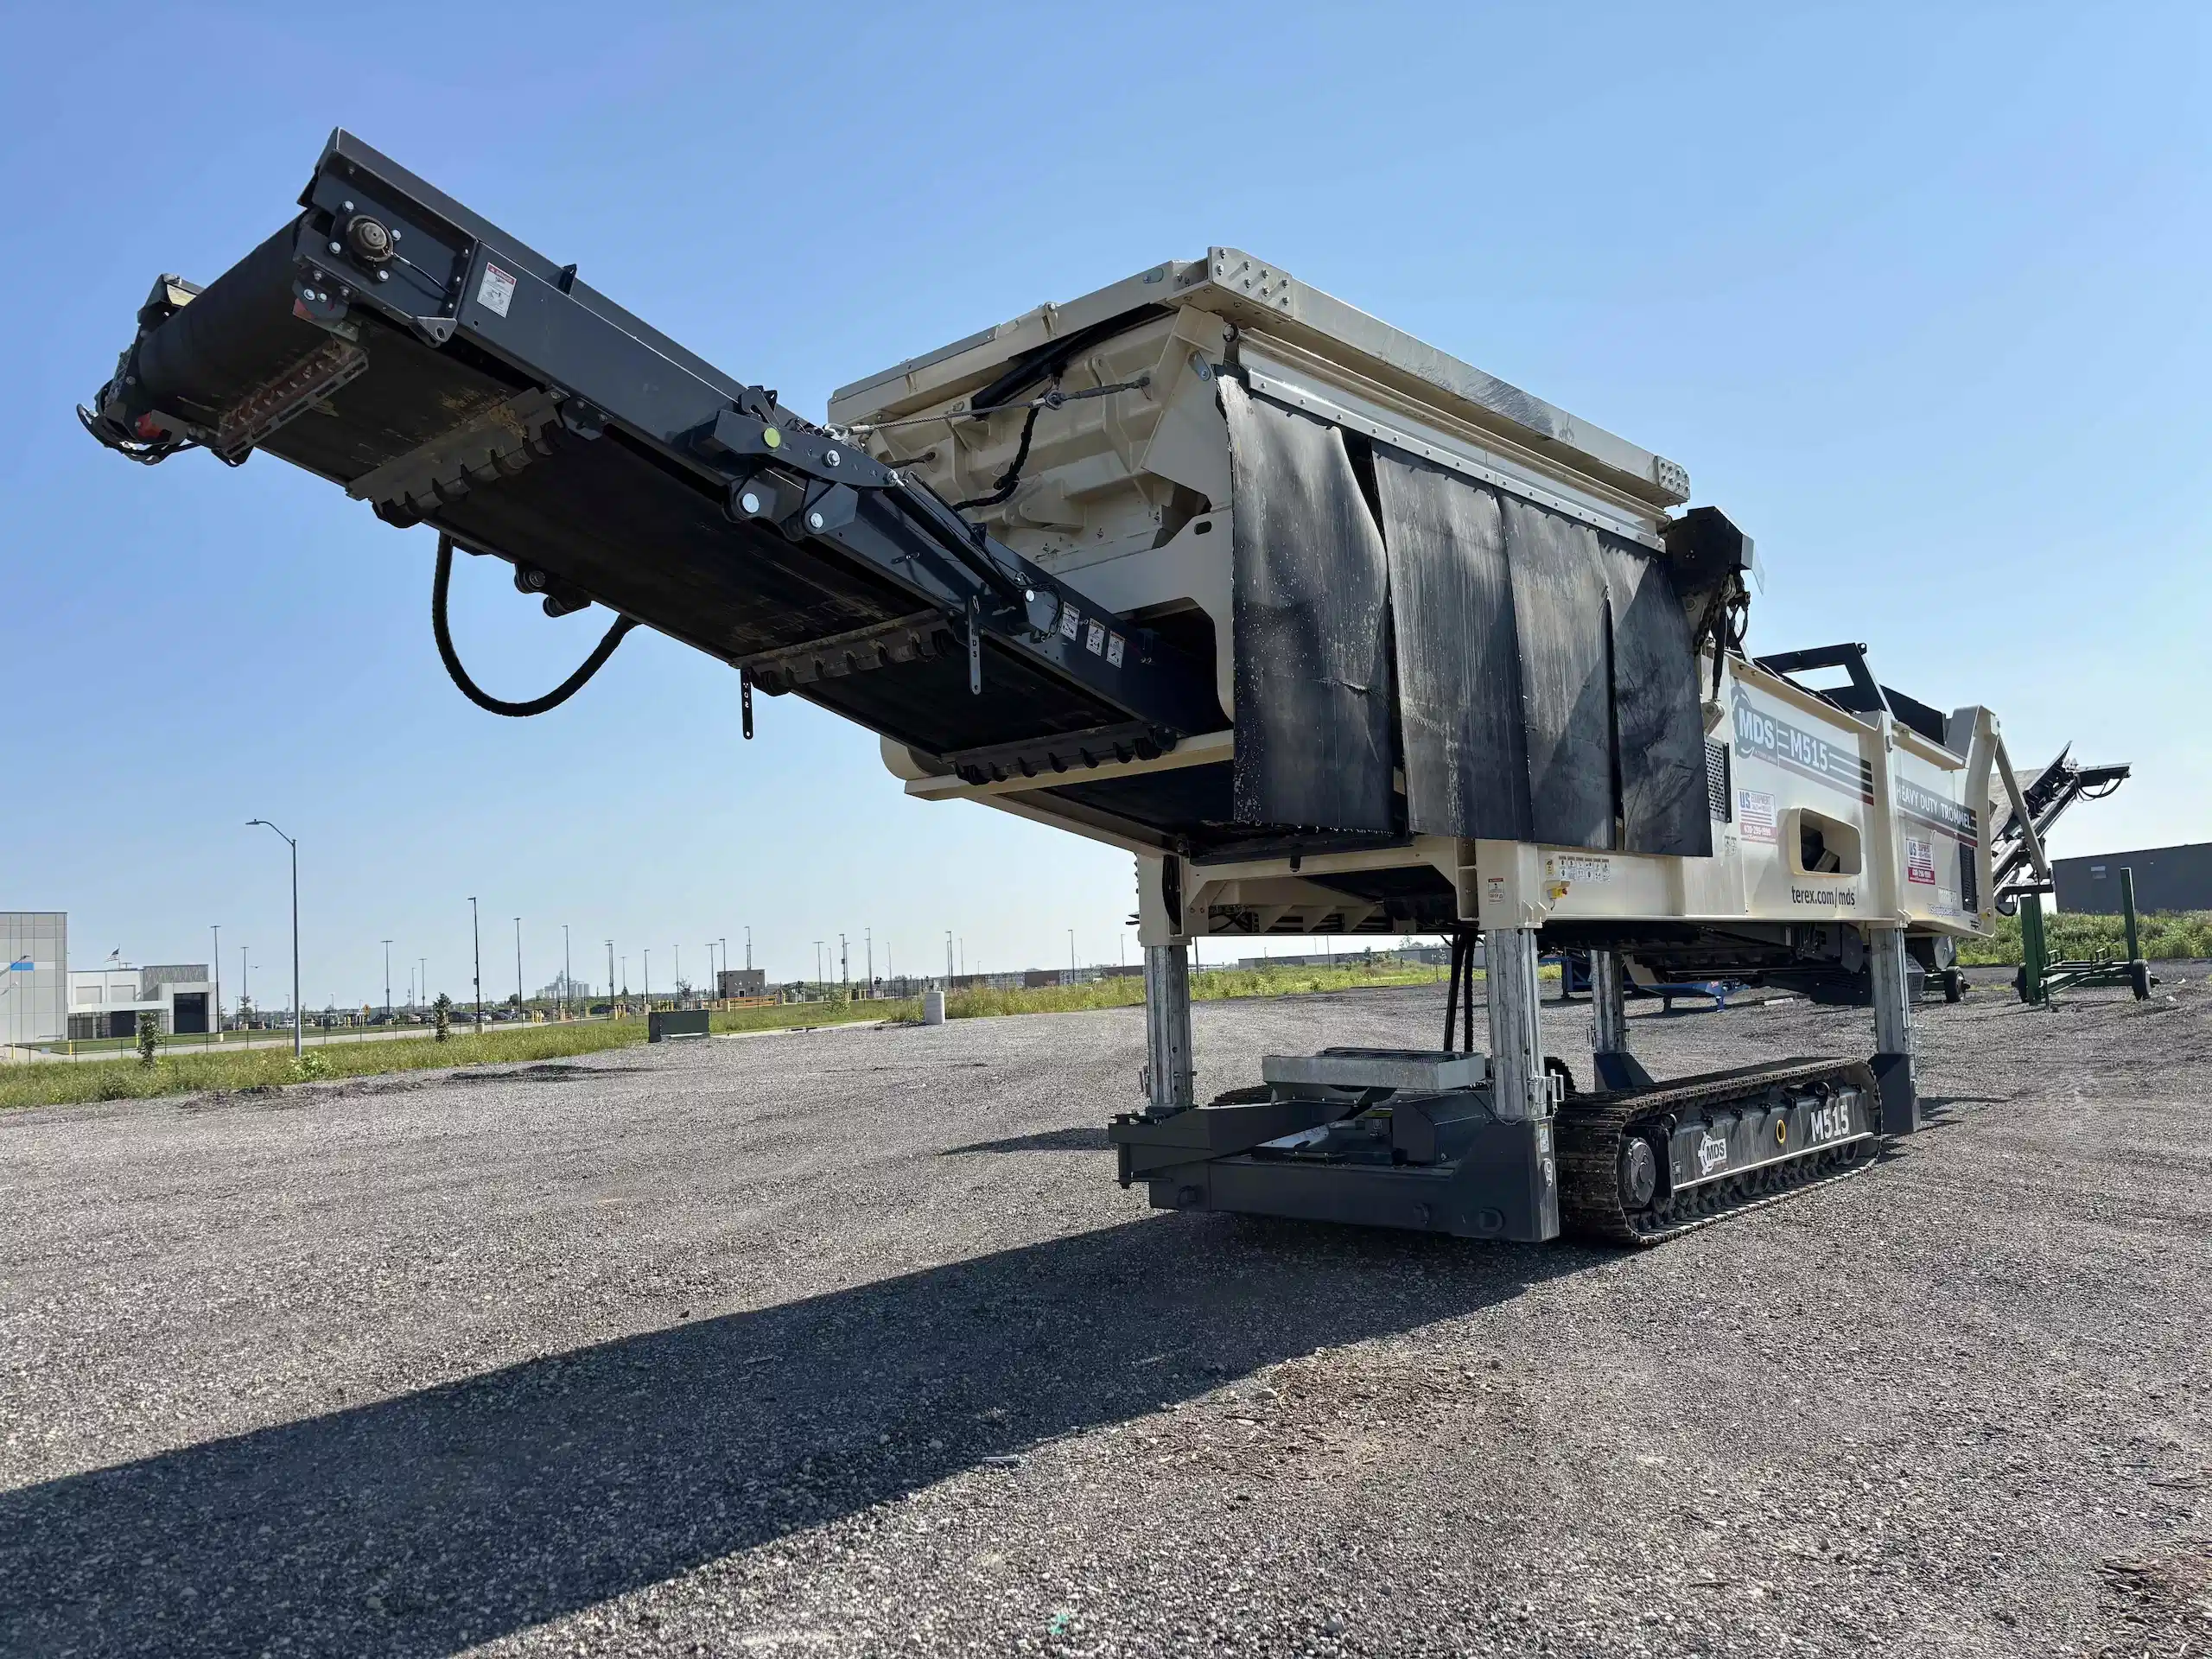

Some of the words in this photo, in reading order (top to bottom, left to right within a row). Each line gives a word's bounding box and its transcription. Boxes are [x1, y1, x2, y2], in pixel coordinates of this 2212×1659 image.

[1738, 707, 1775, 750] MDS
[1790, 728, 1828, 772] M515
[1739, 791, 1751, 810] US
[1895, 781, 1919, 807] HEAVY
[1920, 793, 1938, 815] DUTY
[1909, 842, 1916, 856] US
[1791, 885, 1855, 909] terex.com/mds
[1810, 1104, 1849, 1142] M515
[1707, 1141, 1725, 1161] MDS
